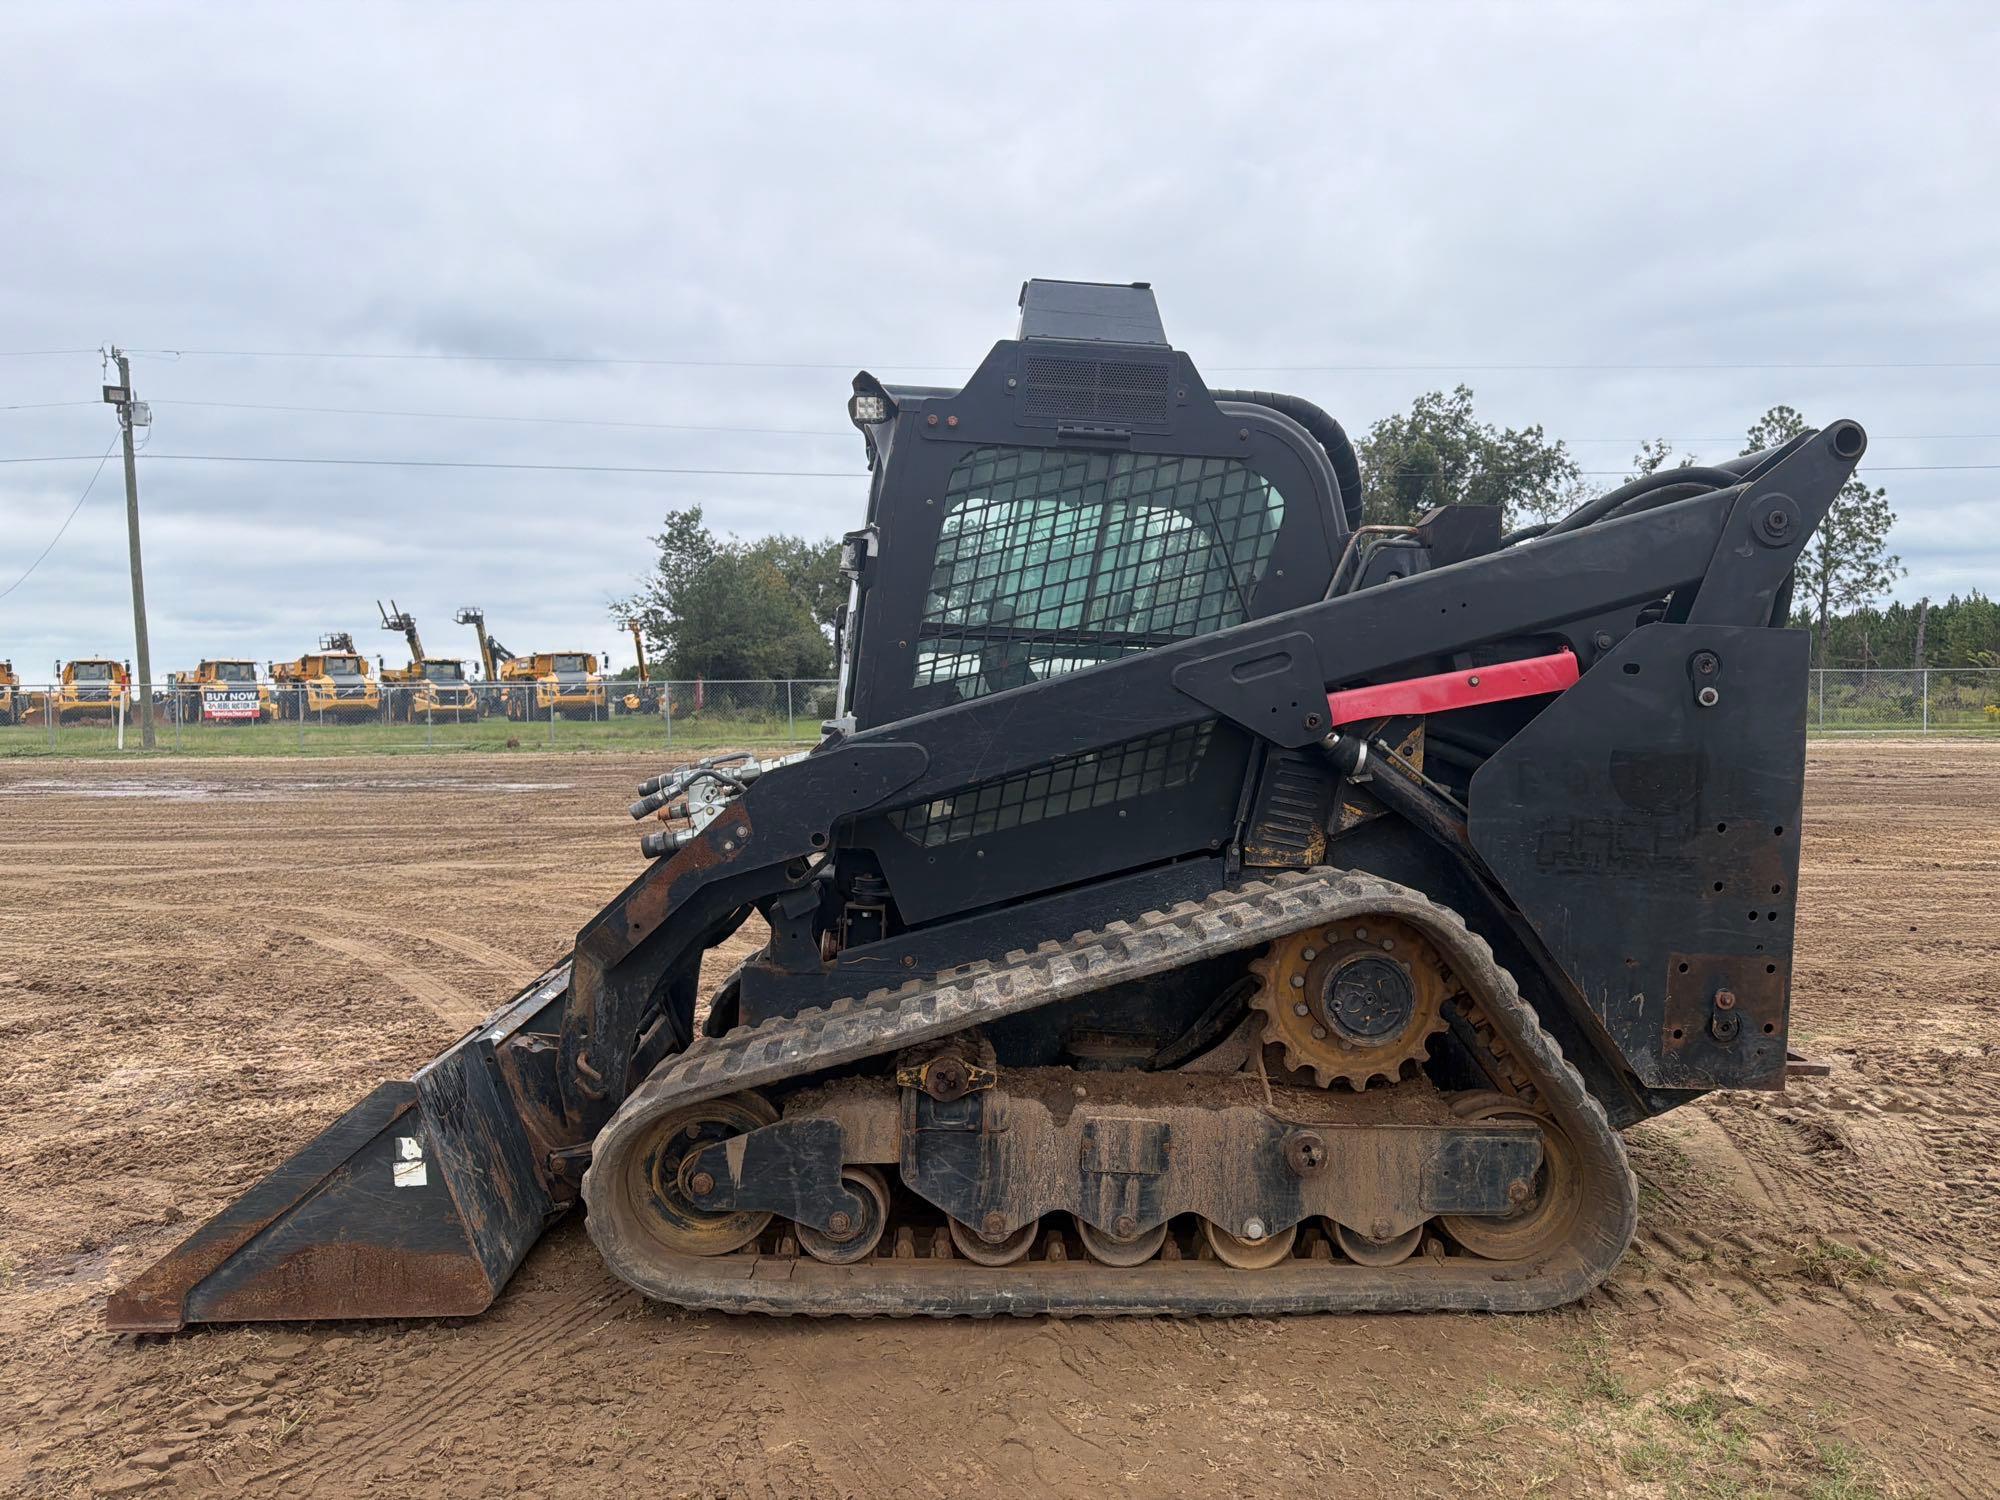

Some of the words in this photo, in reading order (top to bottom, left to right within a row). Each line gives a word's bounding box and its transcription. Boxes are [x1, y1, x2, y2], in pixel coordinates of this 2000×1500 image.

[206, 692, 227, 701] BUY
[229, 691, 257, 701] NOW
[231, 702, 250, 710] AUCTION
